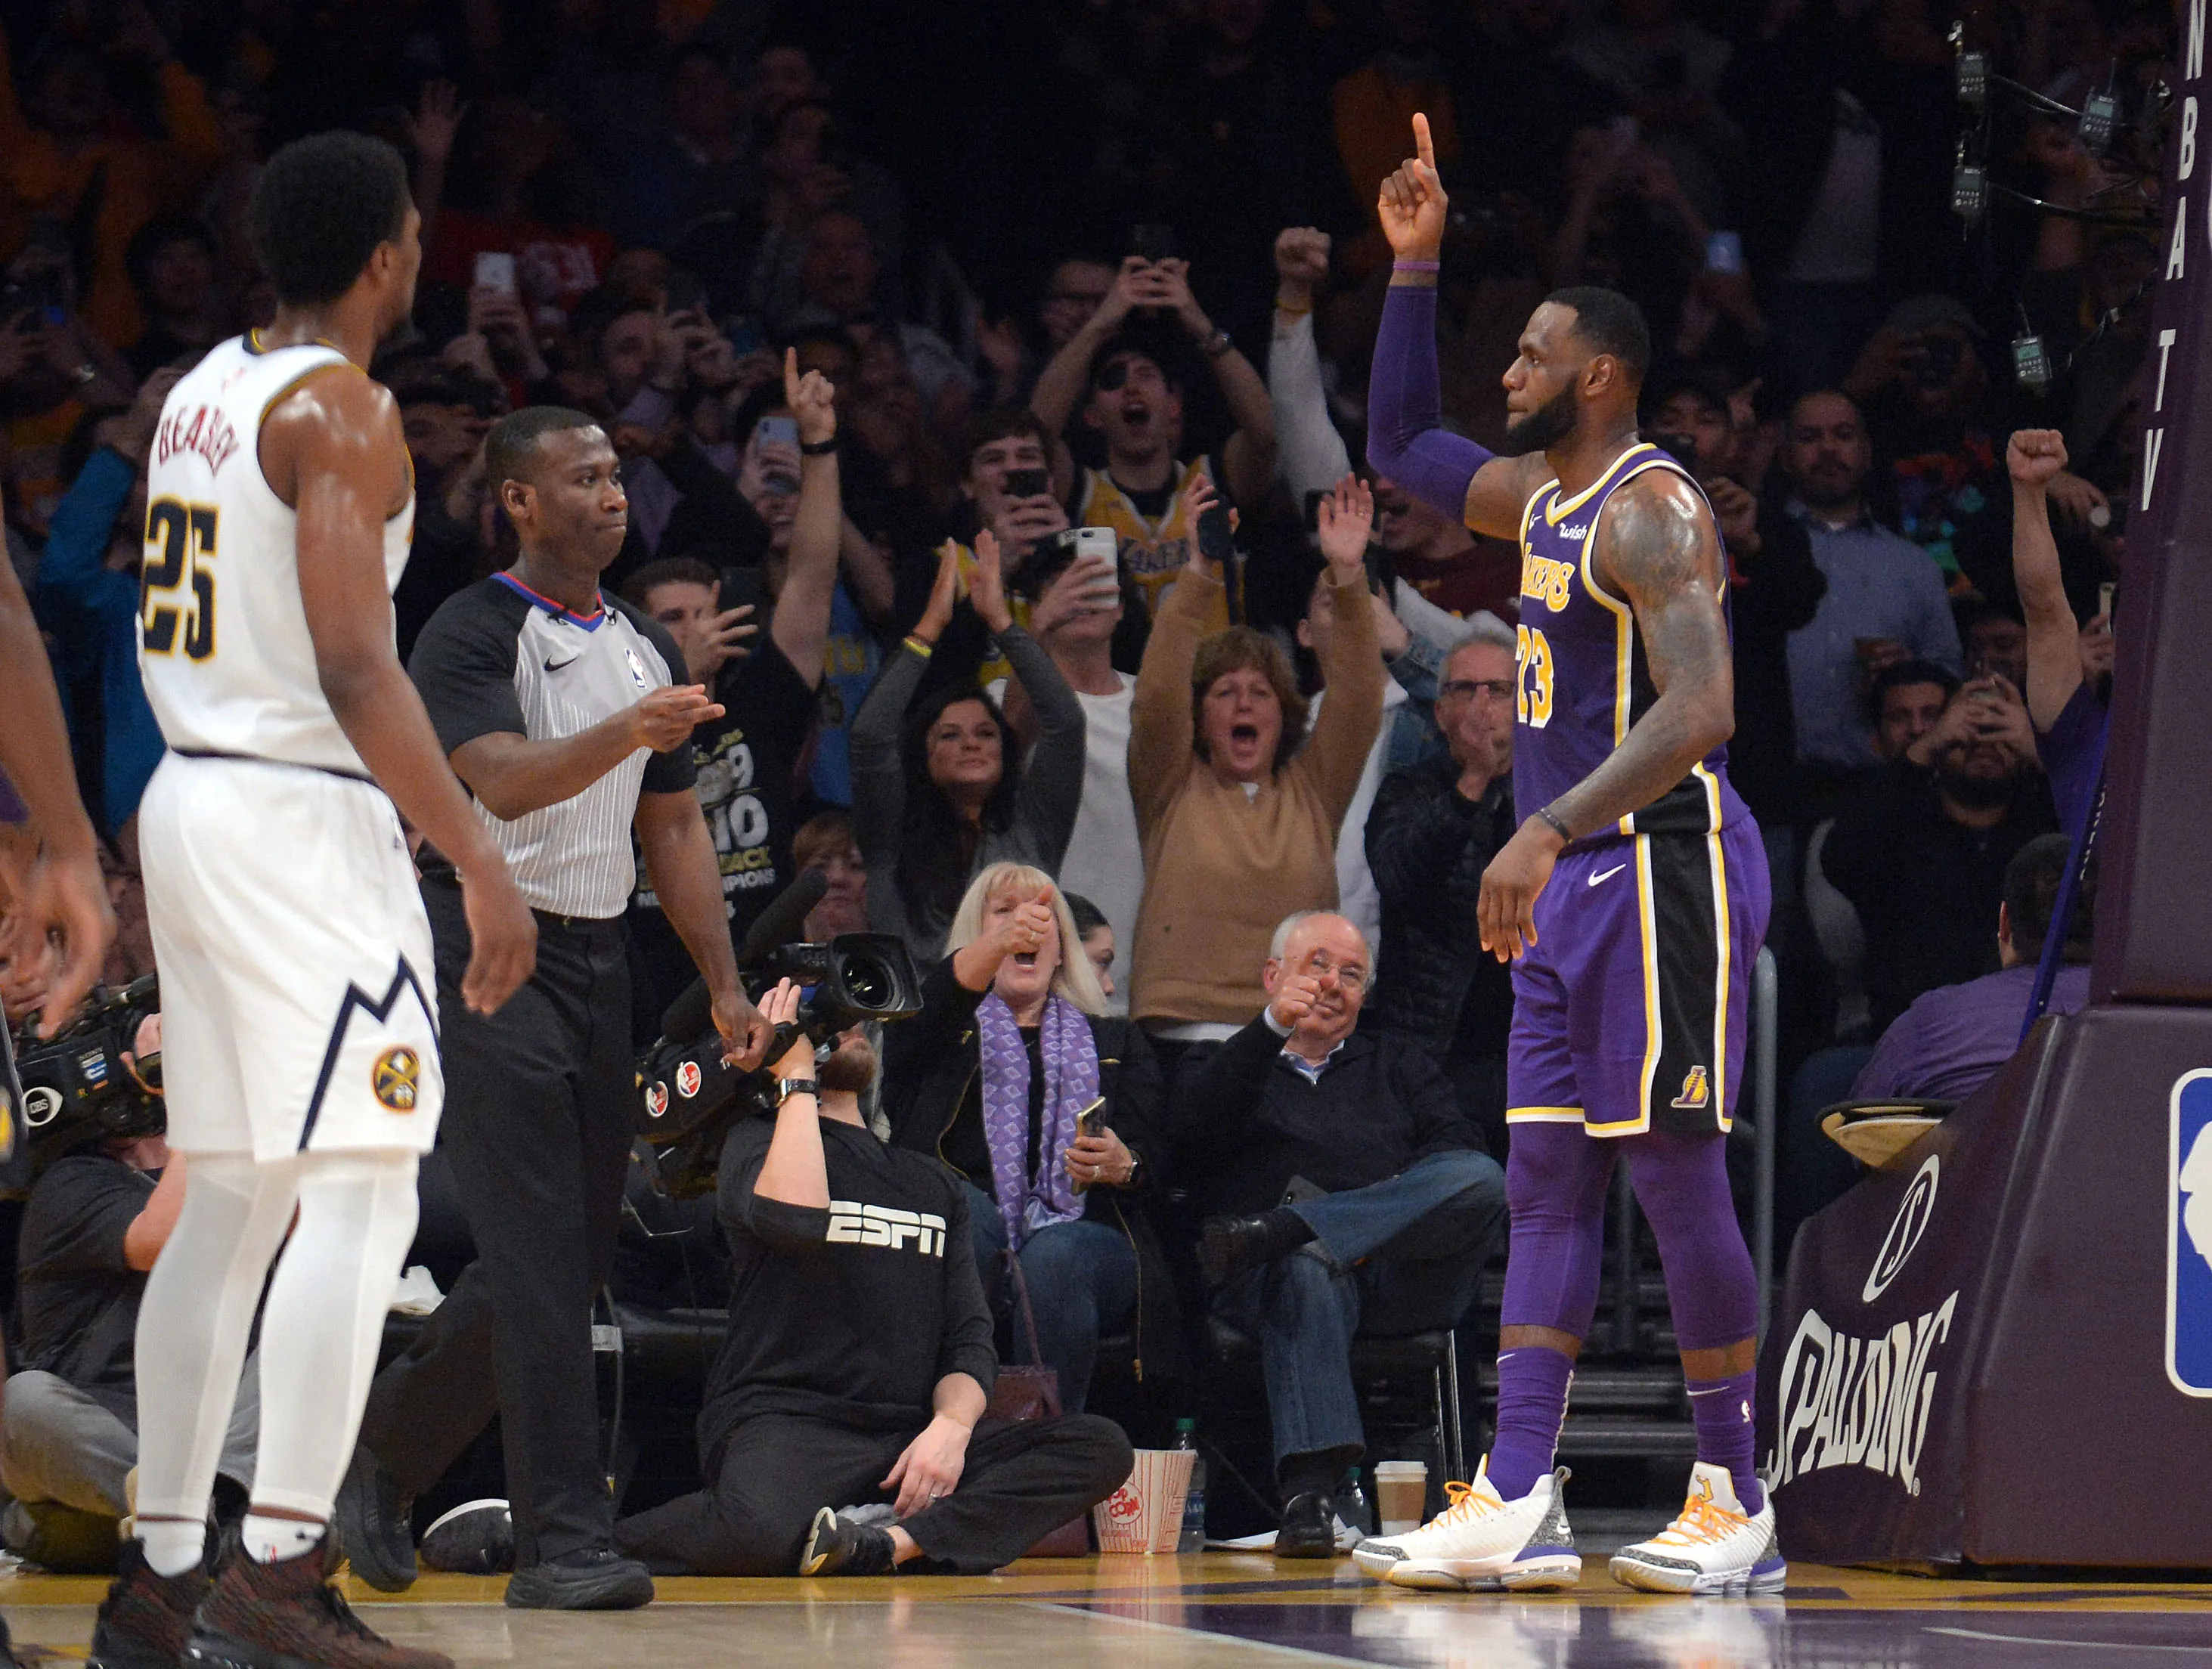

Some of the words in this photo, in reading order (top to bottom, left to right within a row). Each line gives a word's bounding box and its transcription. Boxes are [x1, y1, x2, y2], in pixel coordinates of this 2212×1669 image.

[2141, 328, 2176, 512] TV
[144, 493, 221, 664] 25
[1520, 542, 1575, 613] AKERS
[1515, 624, 1554, 729] 23
[826, 1200, 946, 1258] ESPN
[1767, 1290, 1960, 1494] SPALDING
